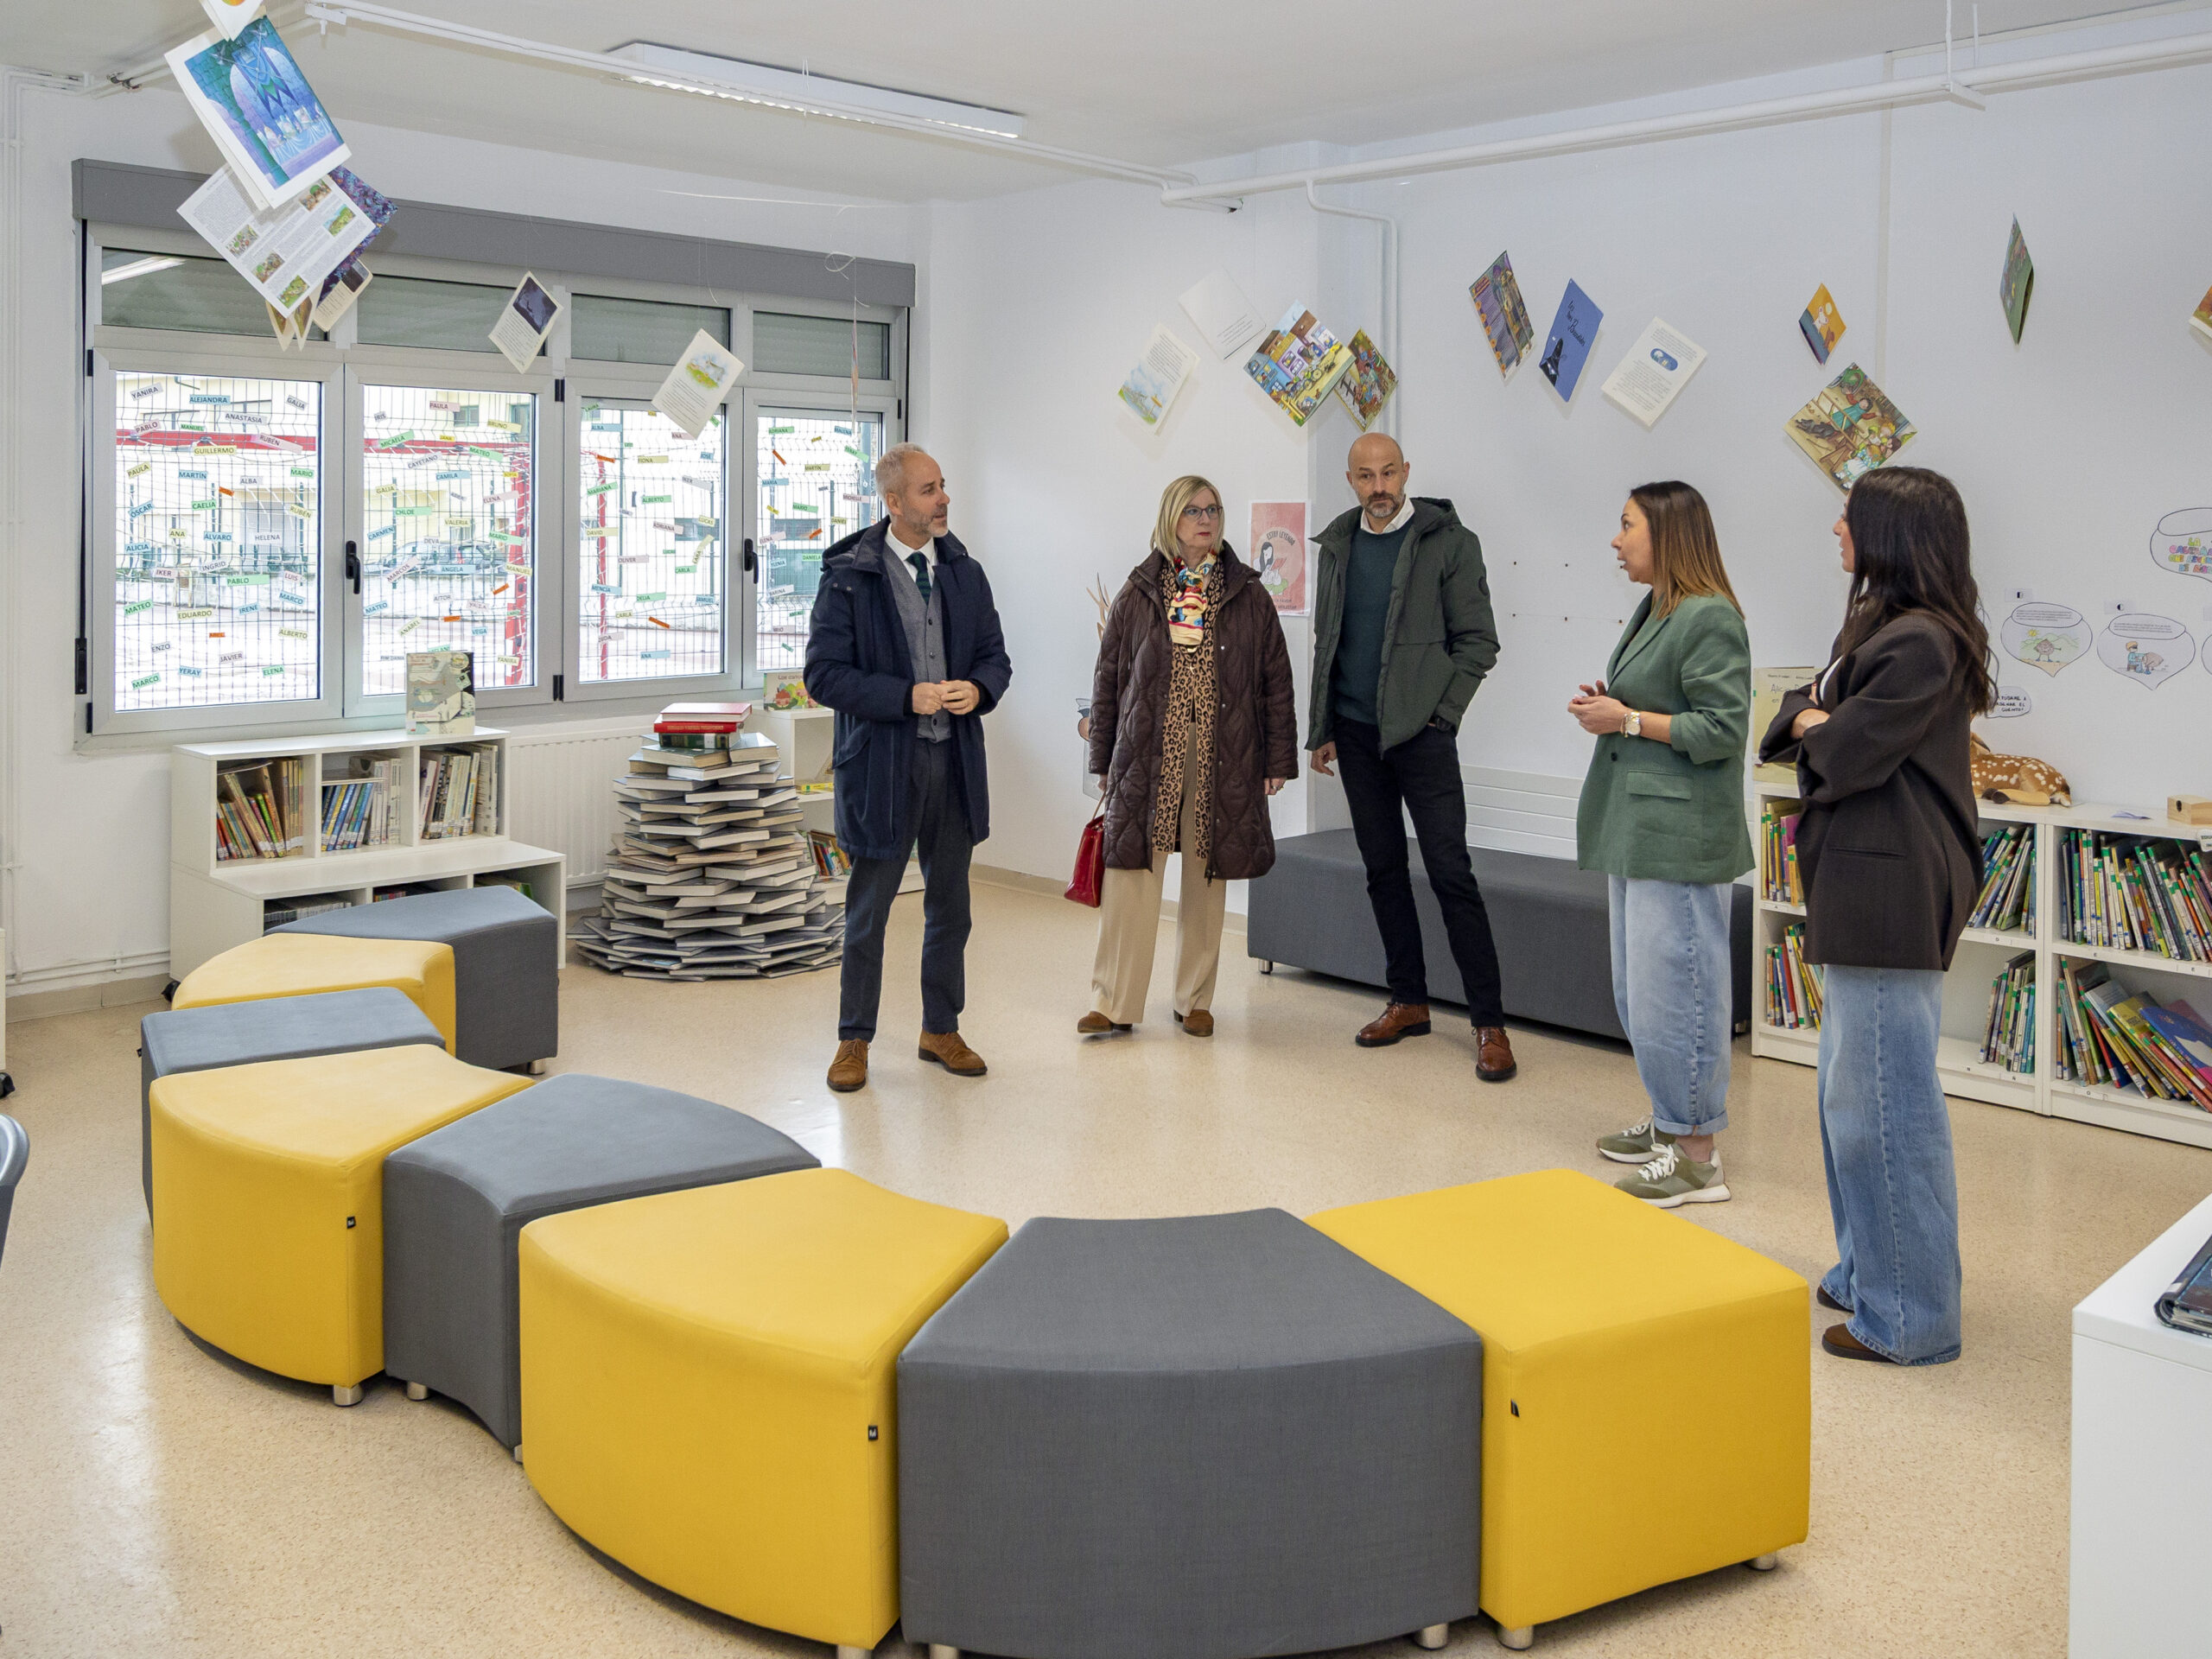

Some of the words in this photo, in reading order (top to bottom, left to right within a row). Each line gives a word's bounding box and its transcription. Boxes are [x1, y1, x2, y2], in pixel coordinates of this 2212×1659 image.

[131, 386, 158, 399] YANIRA
[287, 397, 305, 409] GALIA
[226, 413, 262, 423] ANASTASIA
[136, 422, 158, 433] PABLO
[380, 435, 405, 448] MICAELA
[469, 447, 490, 457] MATEO
[408, 455, 438, 468] CAYETANO
[128, 464, 149, 477] PAULA
[588, 486, 611, 495] MARIANA
[193, 501, 215, 510] CAELIA
[368, 528, 394, 540] CARMEN
[489, 532, 508, 541] MARIO
[1267, 531, 1279, 540] ESTOY
[2188, 537, 2201, 546] LA
[126, 543, 149, 552] ALICIA
[201, 562, 226, 571] INGRID
[387, 564, 410, 582] MARCOS
[280, 593, 302, 604] MARCO
[124, 601, 151, 614] MATEO
[239, 605, 258, 613] IRENE
[365, 602, 388, 613] MATEO
[178, 610, 213, 619] EDUARDO
[400, 620, 421, 636] ANABEL
[279, 629, 307, 639] ALBERTO
[151, 643, 170, 652] ENZO
[220, 653, 243, 662] JAVIER
[132, 676, 159, 689] MARCO
